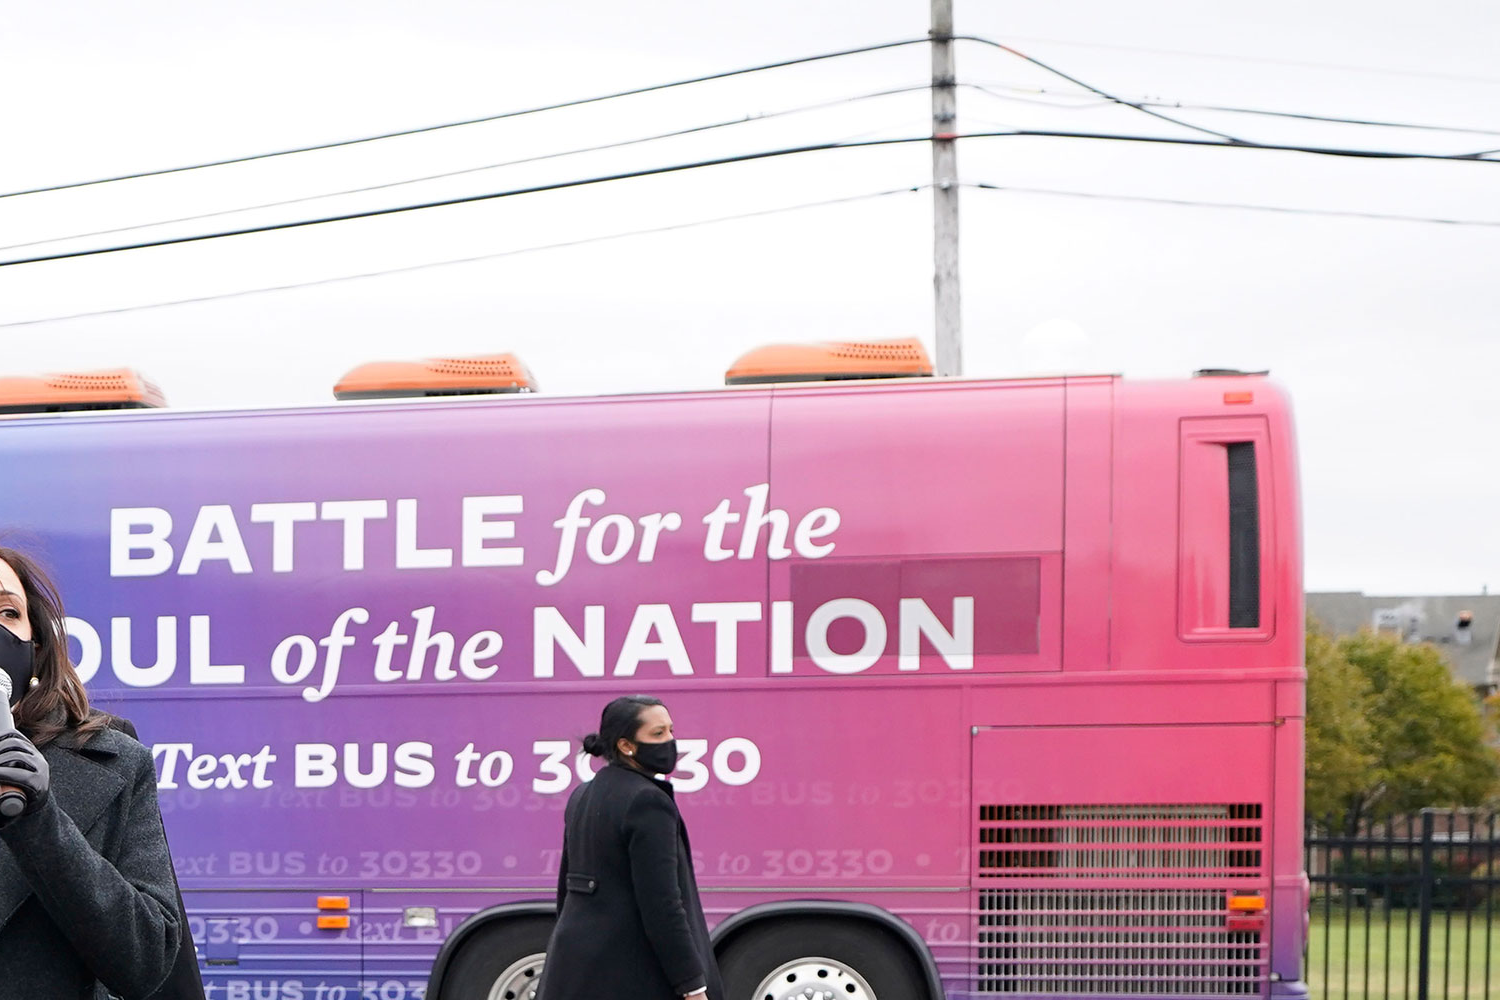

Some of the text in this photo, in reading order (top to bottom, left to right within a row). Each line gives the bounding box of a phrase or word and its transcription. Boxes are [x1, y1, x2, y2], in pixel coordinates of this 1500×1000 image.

[110, 483, 841, 586] BATTLE for the
[52, 597, 975, 702] OUL of the NATION
[153, 737, 761, 794] Text BUS to 330
[176, 850, 483, 879] ext BUS to 30330
[717, 850, 751, 876] to
[761, 849, 893, 878] 30330
[188, 916, 279, 942] 0330
[926, 917, 960, 942] to
